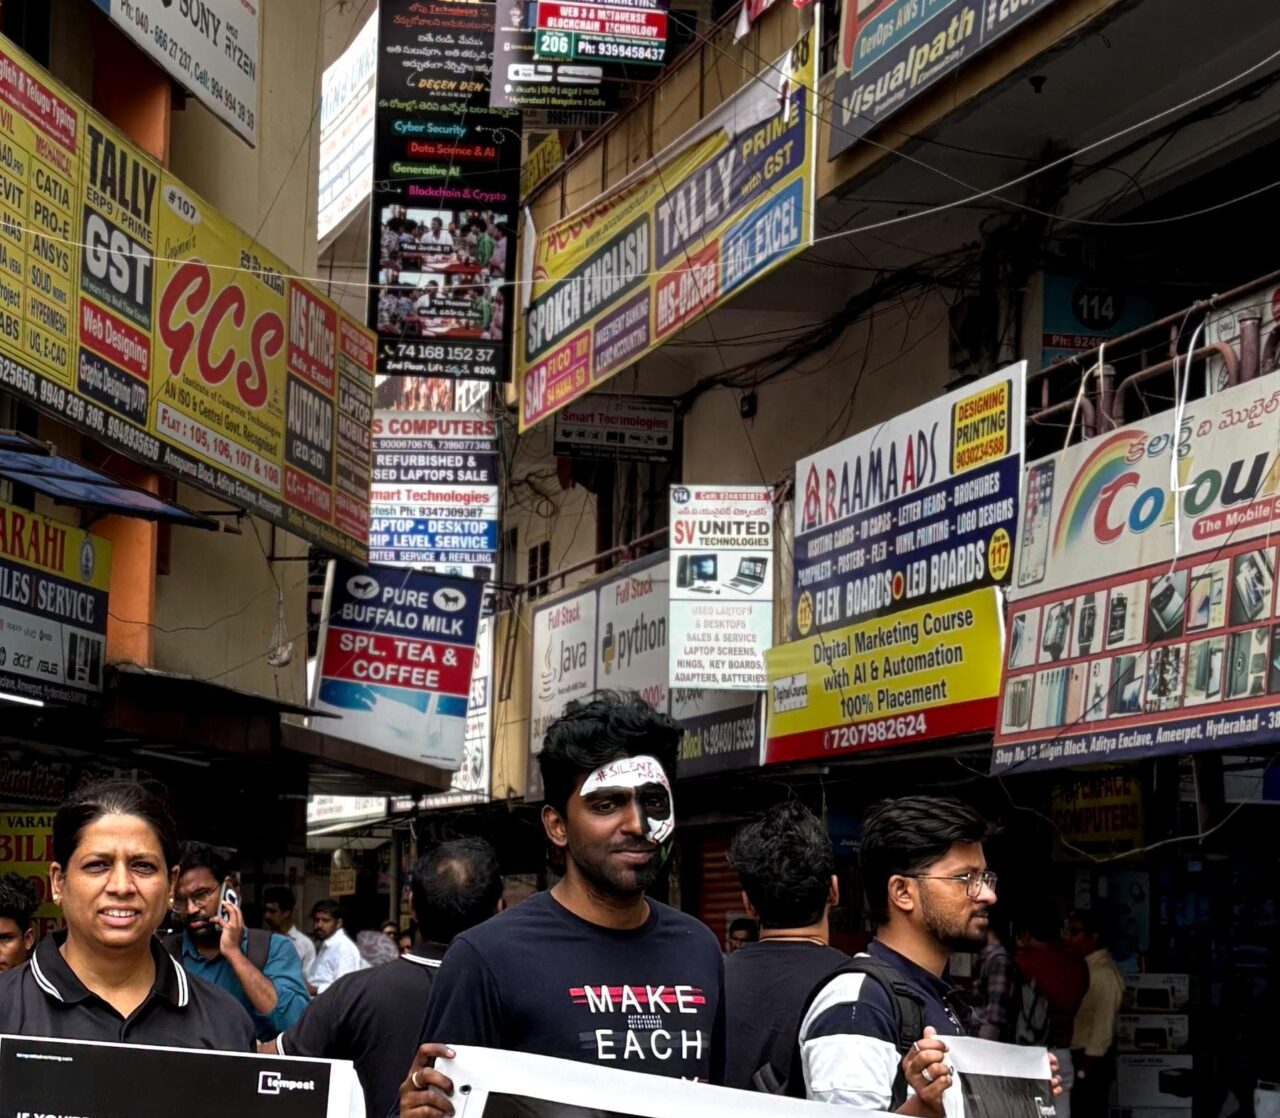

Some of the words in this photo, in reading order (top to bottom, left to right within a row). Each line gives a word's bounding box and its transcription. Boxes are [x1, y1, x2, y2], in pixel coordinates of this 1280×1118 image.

[541, 34, 569, 53] 206
[394, 120, 425, 136] Cyber
[427, 123, 466, 138] Security
[35, 168, 71, 211] CATIA
[86, 124, 157, 227] TALLY
[167, 188, 198, 219] #107
[658, 147, 737, 257] TALLY
[32, 236, 70, 273] ANSYS
[85, 214, 152, 304] GST
[527, 282, 581, 353] SPOKEN
[583, 227, 650, 316] ENGLISH
[82, 313, 108, 343] Web
[108, 319, 149, 372] Designing
[397, 344, 414, 358] 74
[418, 345, 443, 359] 168
[448, 347, 472, 359] 152
[476, 348, 494, 361] 37
[958, 389, 1004, 423] DESIGNING
[387, 419, 496, 437] COMPUTERS
[956, 409, 1006, 446] PRINTING
[376, 454, 463, 469] REFURBISHED
[467, 456, 476, 468] &
[406, 488, 490, 505] Technologies
[428, 520, 488, 535] DESKTOP
[674, 520, 695, 544] SV
[698, 521, 770, 535] UNITED
[1199, 521, 1221, 535] The
[1225, 506, 1272, 528] Mobile
[699, 537, 769, 546] TECHNOLOGIES
[990, 543, 1009, 565] 117
[846, 569, 892, 616] BOARDS
[905, 563, 928, 597] LED
[930, 540, 984, 595] BOARDS
[37, 579, 96, 625] SERVICE
[382, 587, 429, 609] PURE
[341, 603, 418, 630] BUFFALO
[422, 614, 464, 636] MILK
[339, 634, 386, 657] SPL.
[394, 642, 437, 664] TEA
[441, 649, 458, 667] &
[619, 612, 666, 670] python
[814, 635, 851, 666] Digital
[854, 621, 920, 654] Marketing
[923, 608, 973, 636] Course
[352, 659, 440, 689] COFFEE
[823, 666, 849, 692] with
[853, 663, 866, 686] AI
[869, 662, 879, 682] &
[883, 644, 963, 680] Automation
[841, 692, 874, 719] 100%
[876, 680, 947, 713] Placement
[584, 984, 697, 1013] MAKE
[595, 1029, 702, 1060] EACH
